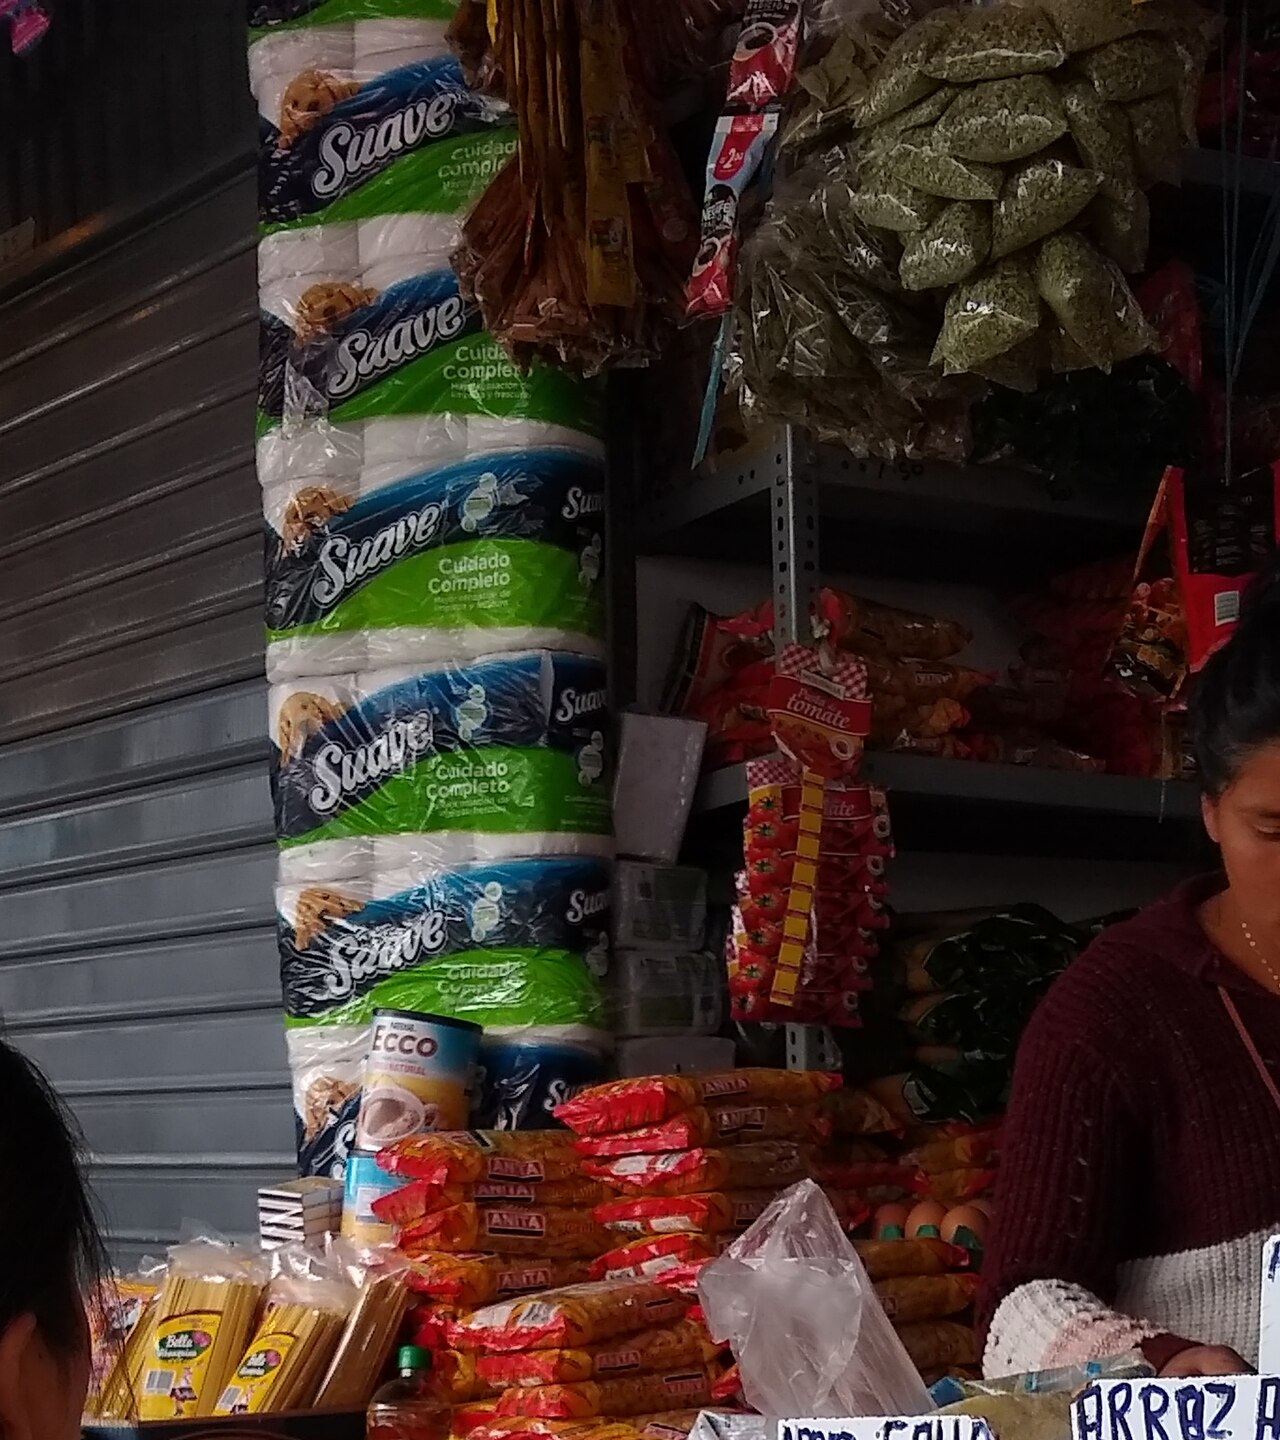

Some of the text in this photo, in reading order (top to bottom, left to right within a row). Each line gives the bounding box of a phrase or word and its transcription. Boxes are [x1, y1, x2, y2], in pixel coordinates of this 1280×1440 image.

[313, 92, 455, 196] Suave
[450, 139, 520, 160] Cuidad
[438, 155, 508, 178] Comple
[328, 294, 464, 398] Suave
[455, 346, 509, 362] Cuida
[313, 503, 441, 606] Suave
[438, 553, 510, 575] Cuidado
[427, 572, 510, 595] Completo
[785, 693, 852, 729] tomate
[311, 711, 433, 813] Suave
[435, 761, 509, 782] Cuidado
[426, 778, 511, 800] Completo
[372, 1024, 439, 1058] ECCO
[490, 1211, 542, 1229] ANITA
[501, 1269, 548, 1287] AITA
